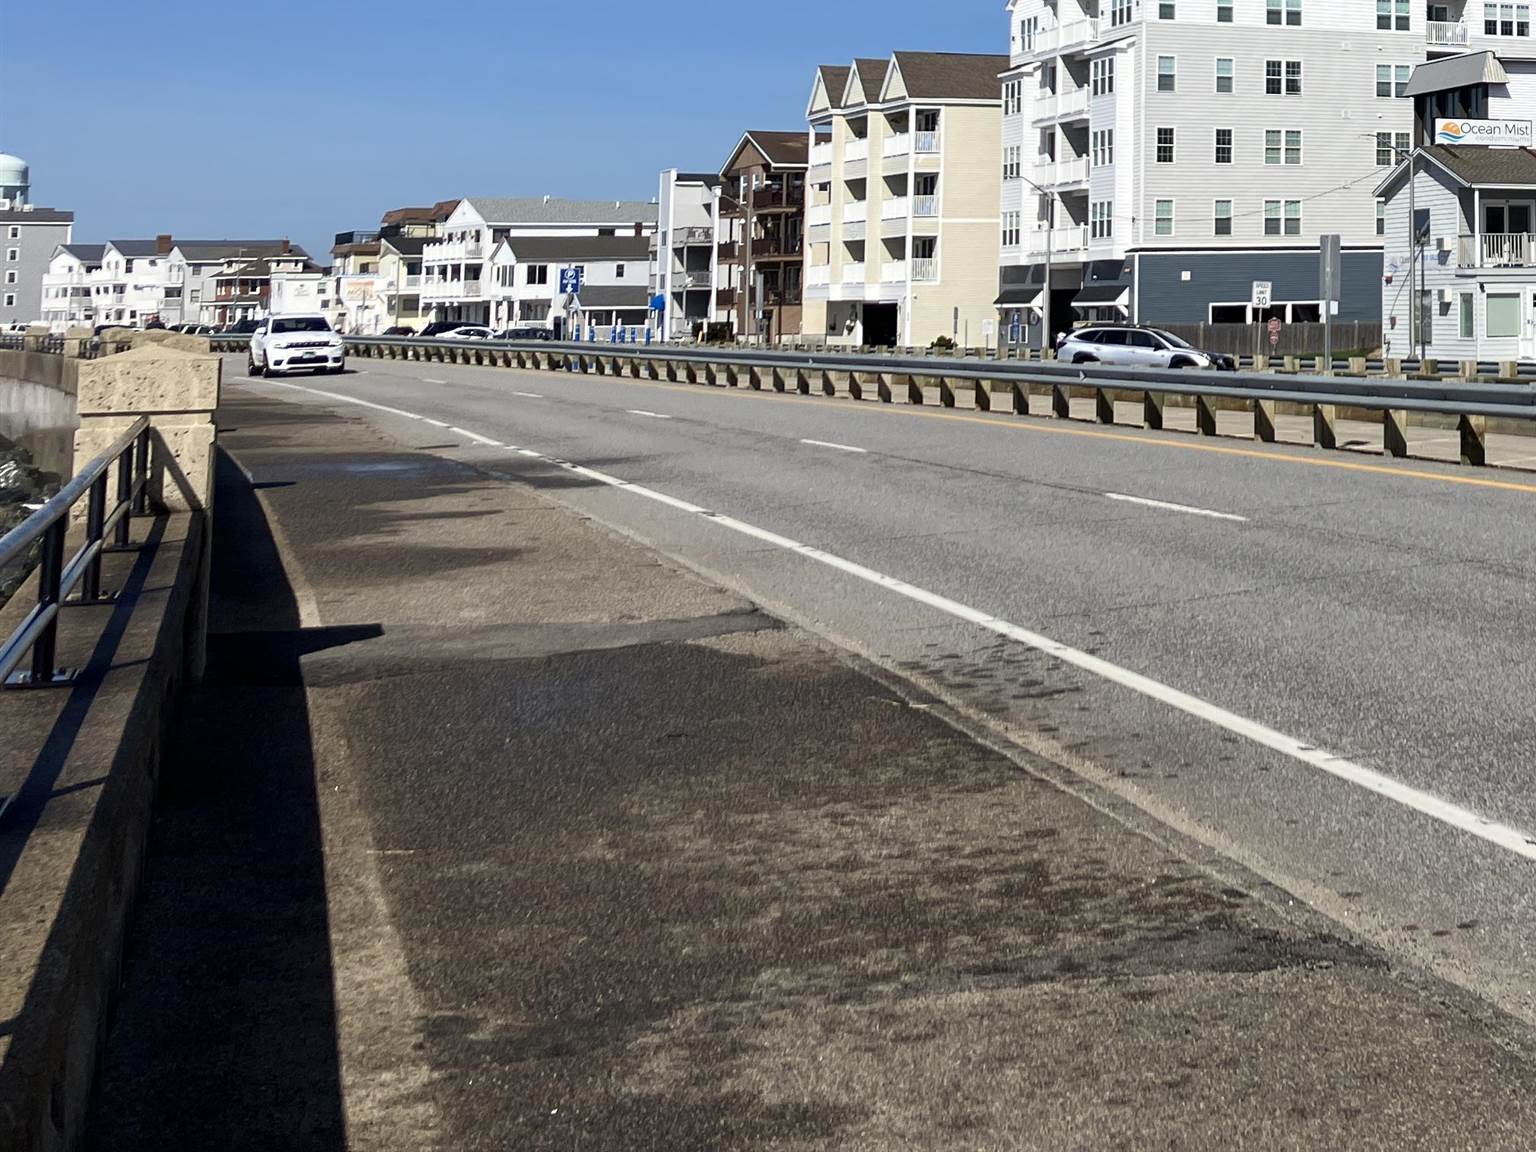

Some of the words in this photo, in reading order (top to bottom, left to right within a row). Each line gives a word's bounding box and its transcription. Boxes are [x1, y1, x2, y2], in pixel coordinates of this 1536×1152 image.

[1460, 122, 1501, 135] Ocean
[1504, 123, 1529, 136] Mist
[1255, 296, 1267, 306] 30
